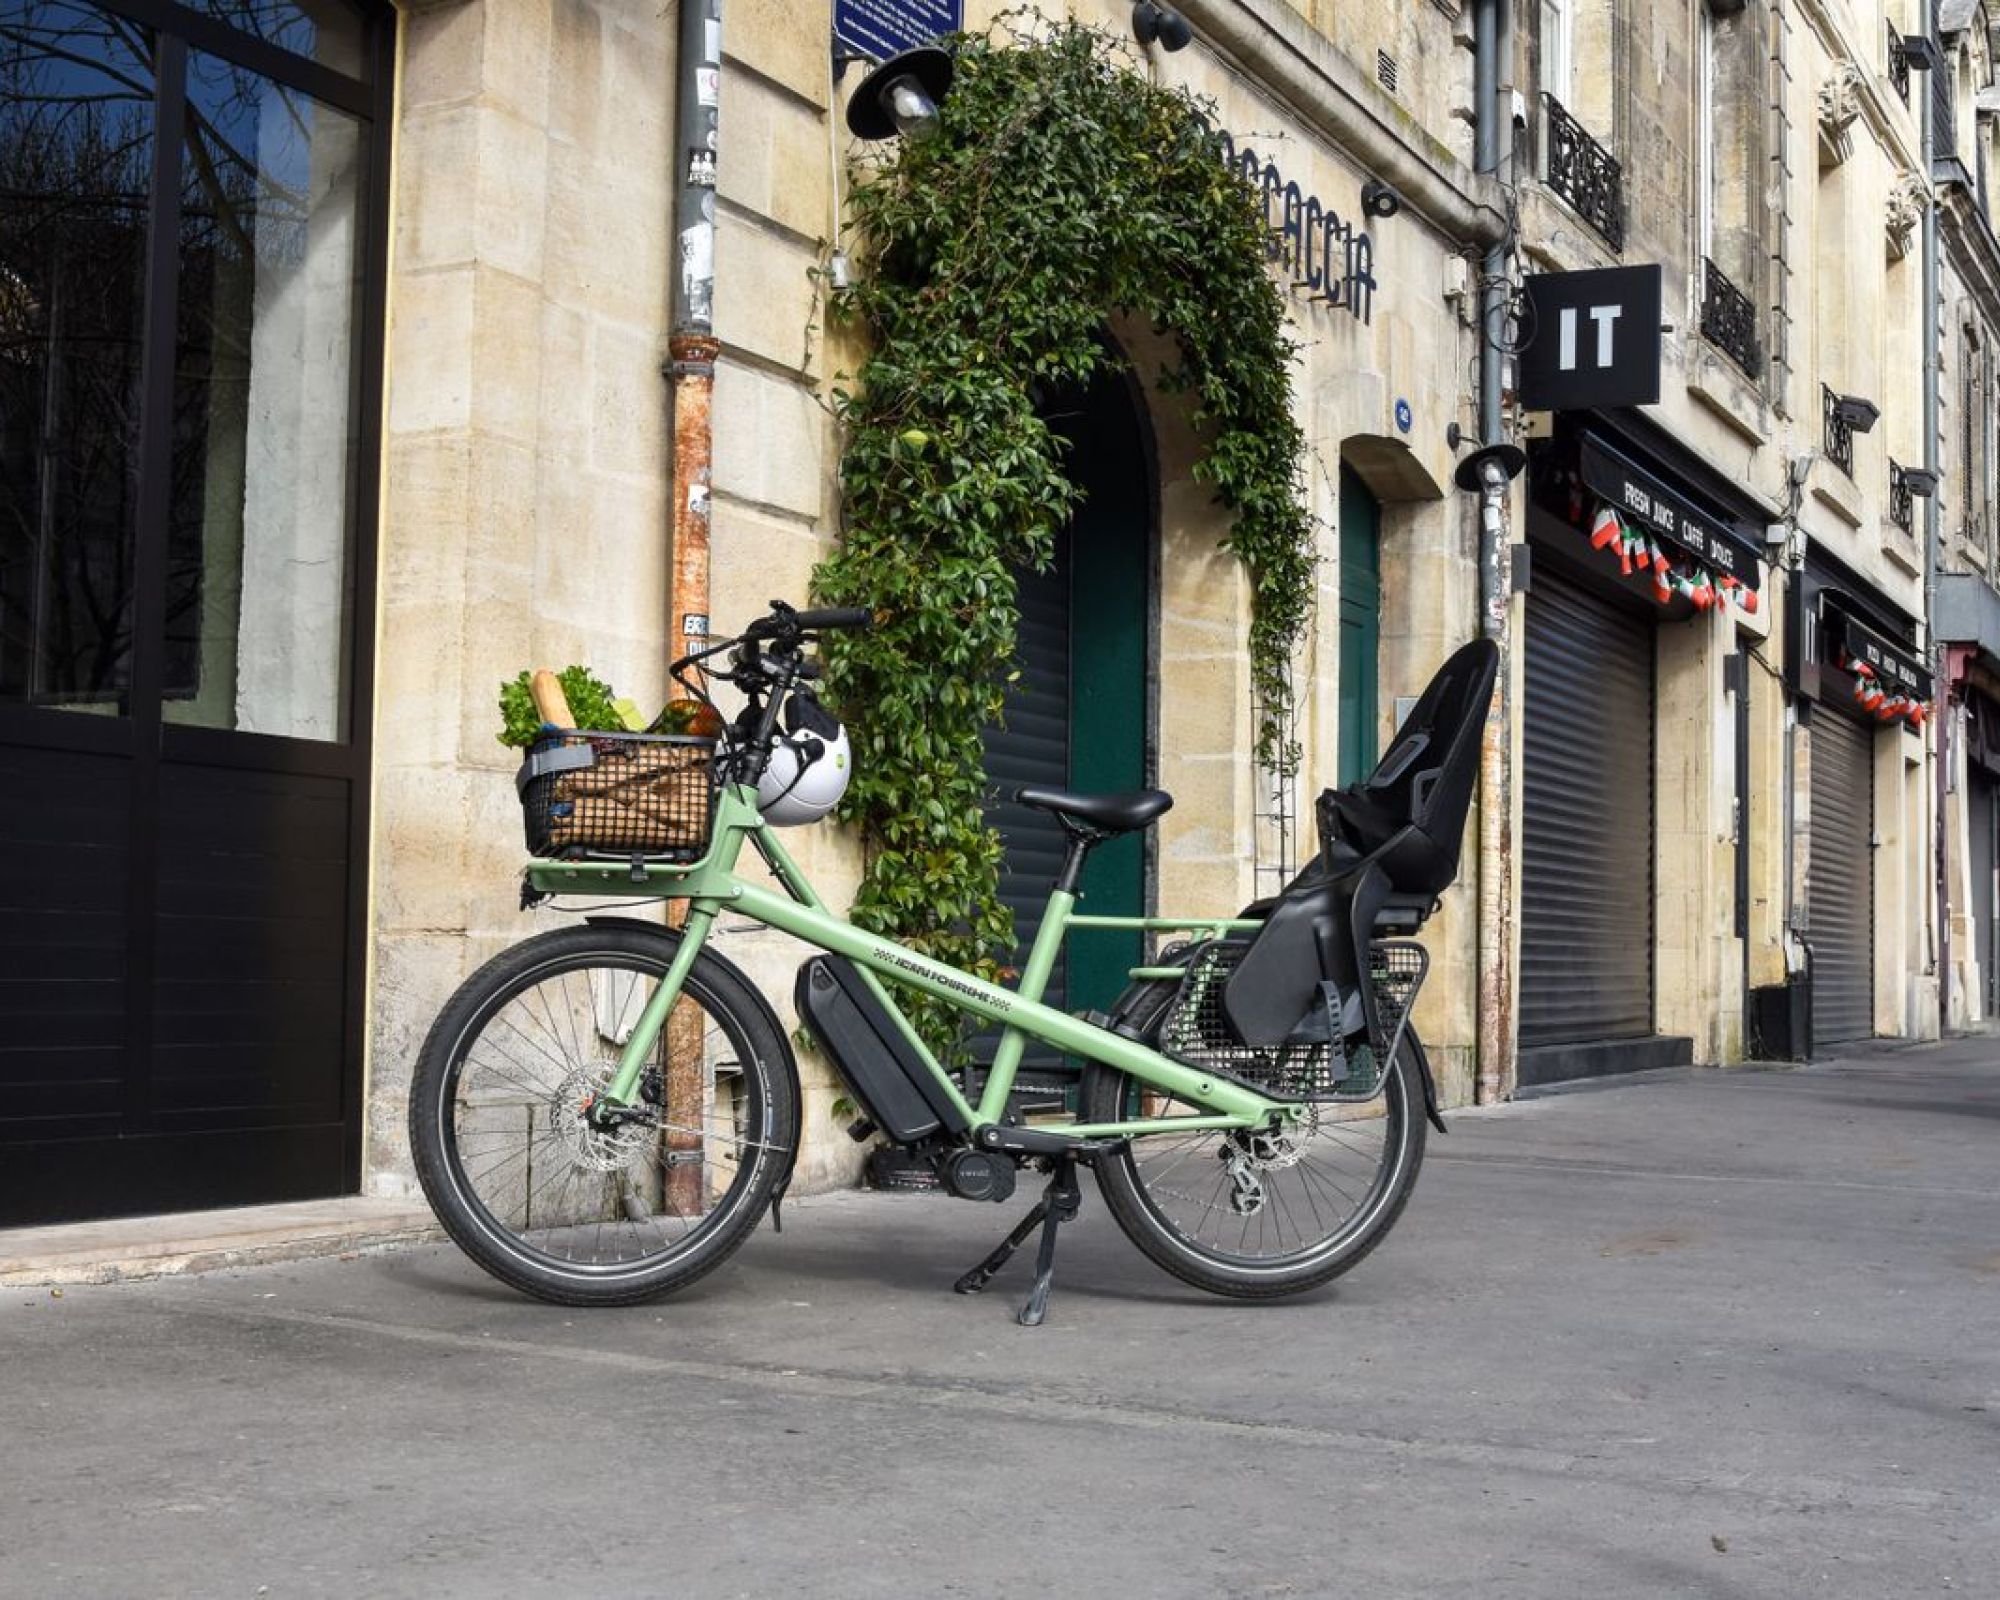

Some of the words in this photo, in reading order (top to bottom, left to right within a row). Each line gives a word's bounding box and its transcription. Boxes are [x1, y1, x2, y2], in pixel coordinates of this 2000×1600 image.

[1560, 304, 1622, 370] IT
[1623, 482, 1650, 516] FRESH
[1653, 501, 1674, 531] JUICE
